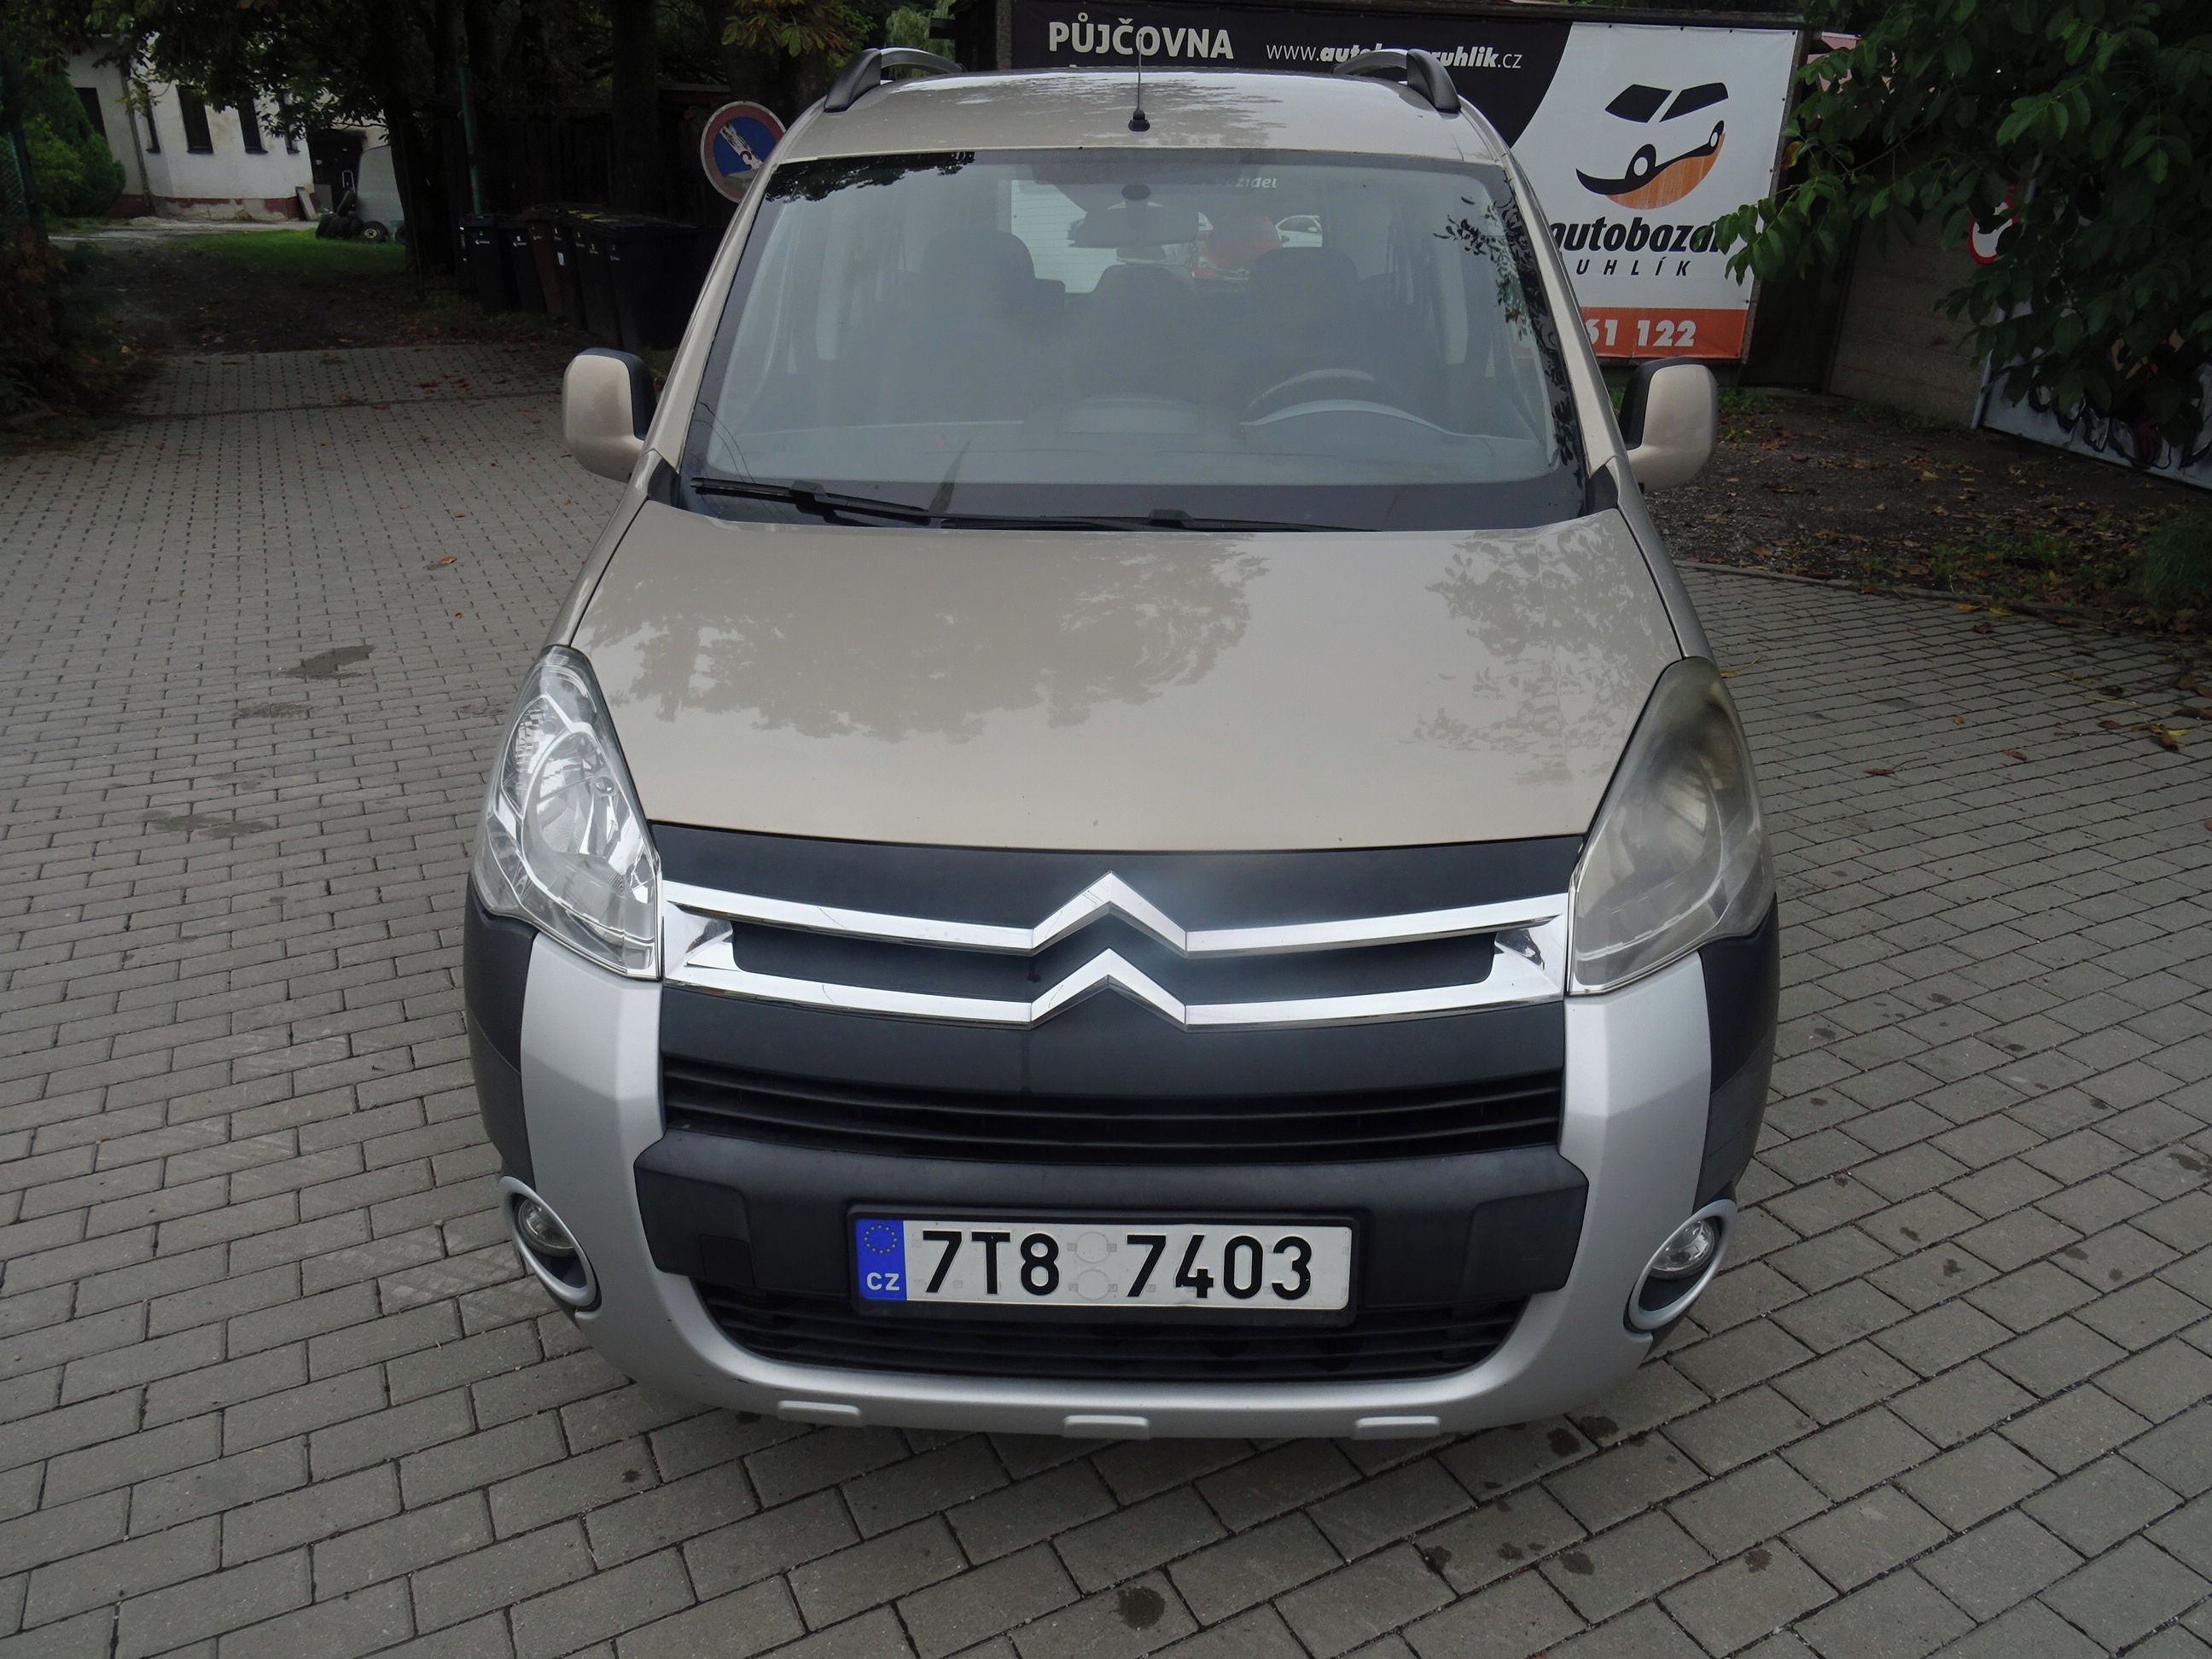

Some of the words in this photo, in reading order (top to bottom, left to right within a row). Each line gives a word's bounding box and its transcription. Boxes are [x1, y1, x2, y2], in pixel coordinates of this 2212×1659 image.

[1049, 12, 1234, 60] PŮJČOVNA
[1266, 43, 1522, 69] www.autuhlik.cz
[1551, 216, 1719, 253] autobaza
[1575, 256, 1691, 276] UHLÍK
[1638, 319, 1697, 347] 122
[923, 1230, 1061, 1296] 7T8
[1126, 1233, 1313, 1301] 7403
[865, 1272, 900, 1291] CZ
